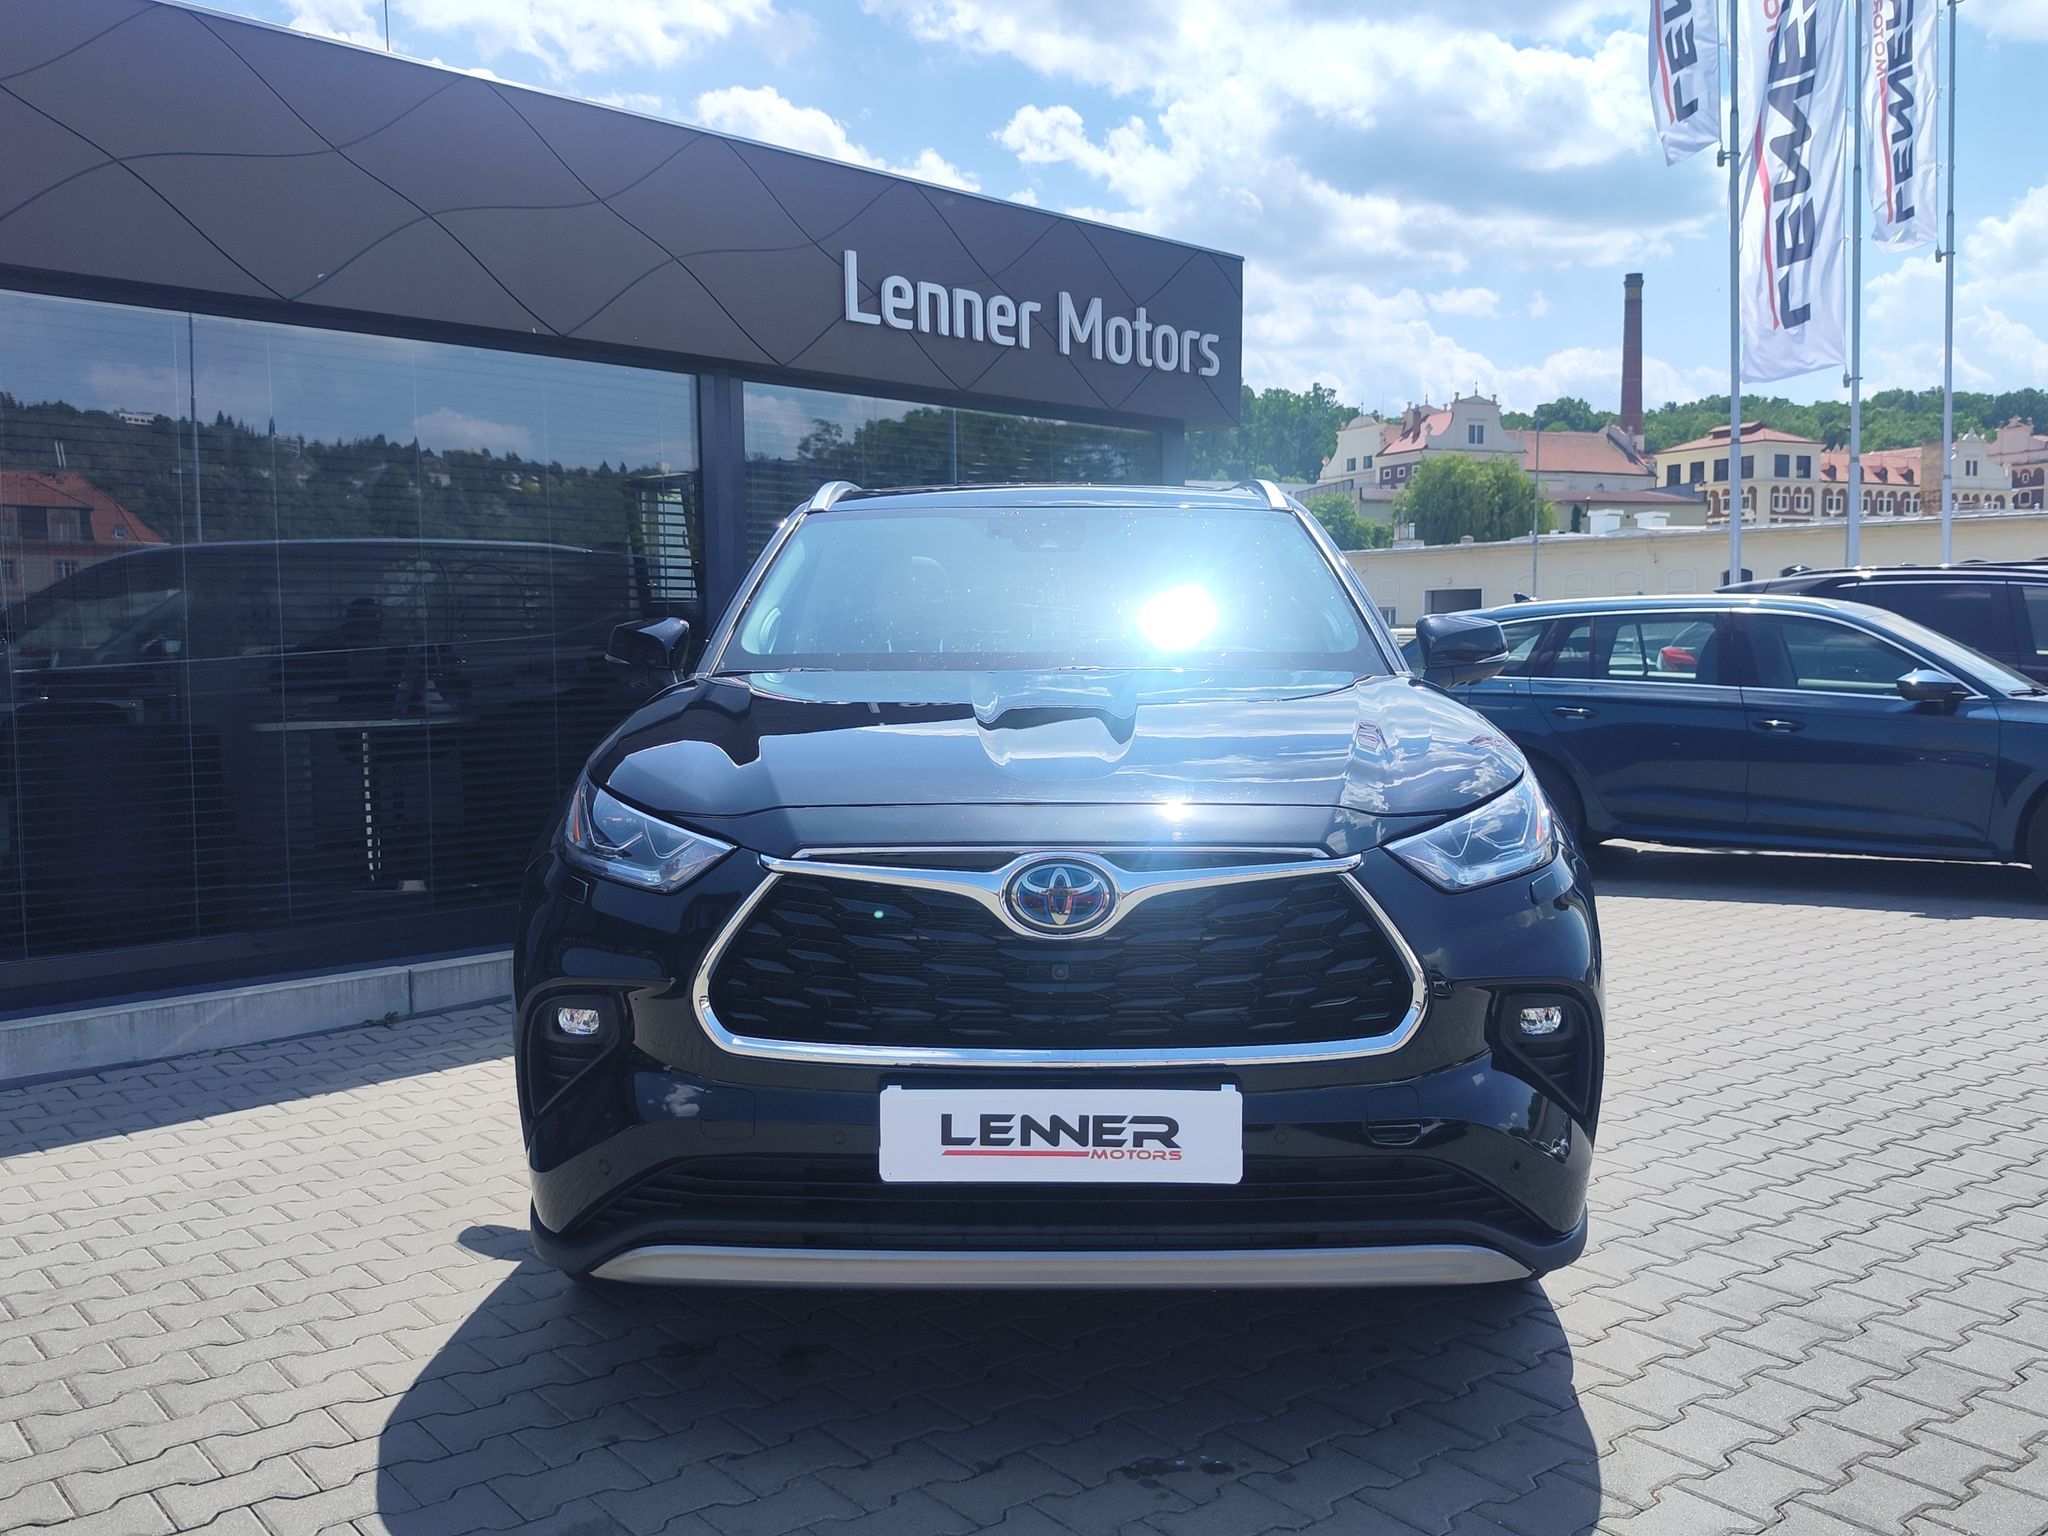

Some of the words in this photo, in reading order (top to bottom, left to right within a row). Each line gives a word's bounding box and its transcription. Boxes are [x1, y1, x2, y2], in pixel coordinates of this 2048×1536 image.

[844, 249, 1042, 350] Lenner
[1058, 291, 1220, 377] Motors
[941, 1113, 1182, 1148] LENNER
[1090, 1149, 1182, 1161] MOTORS
